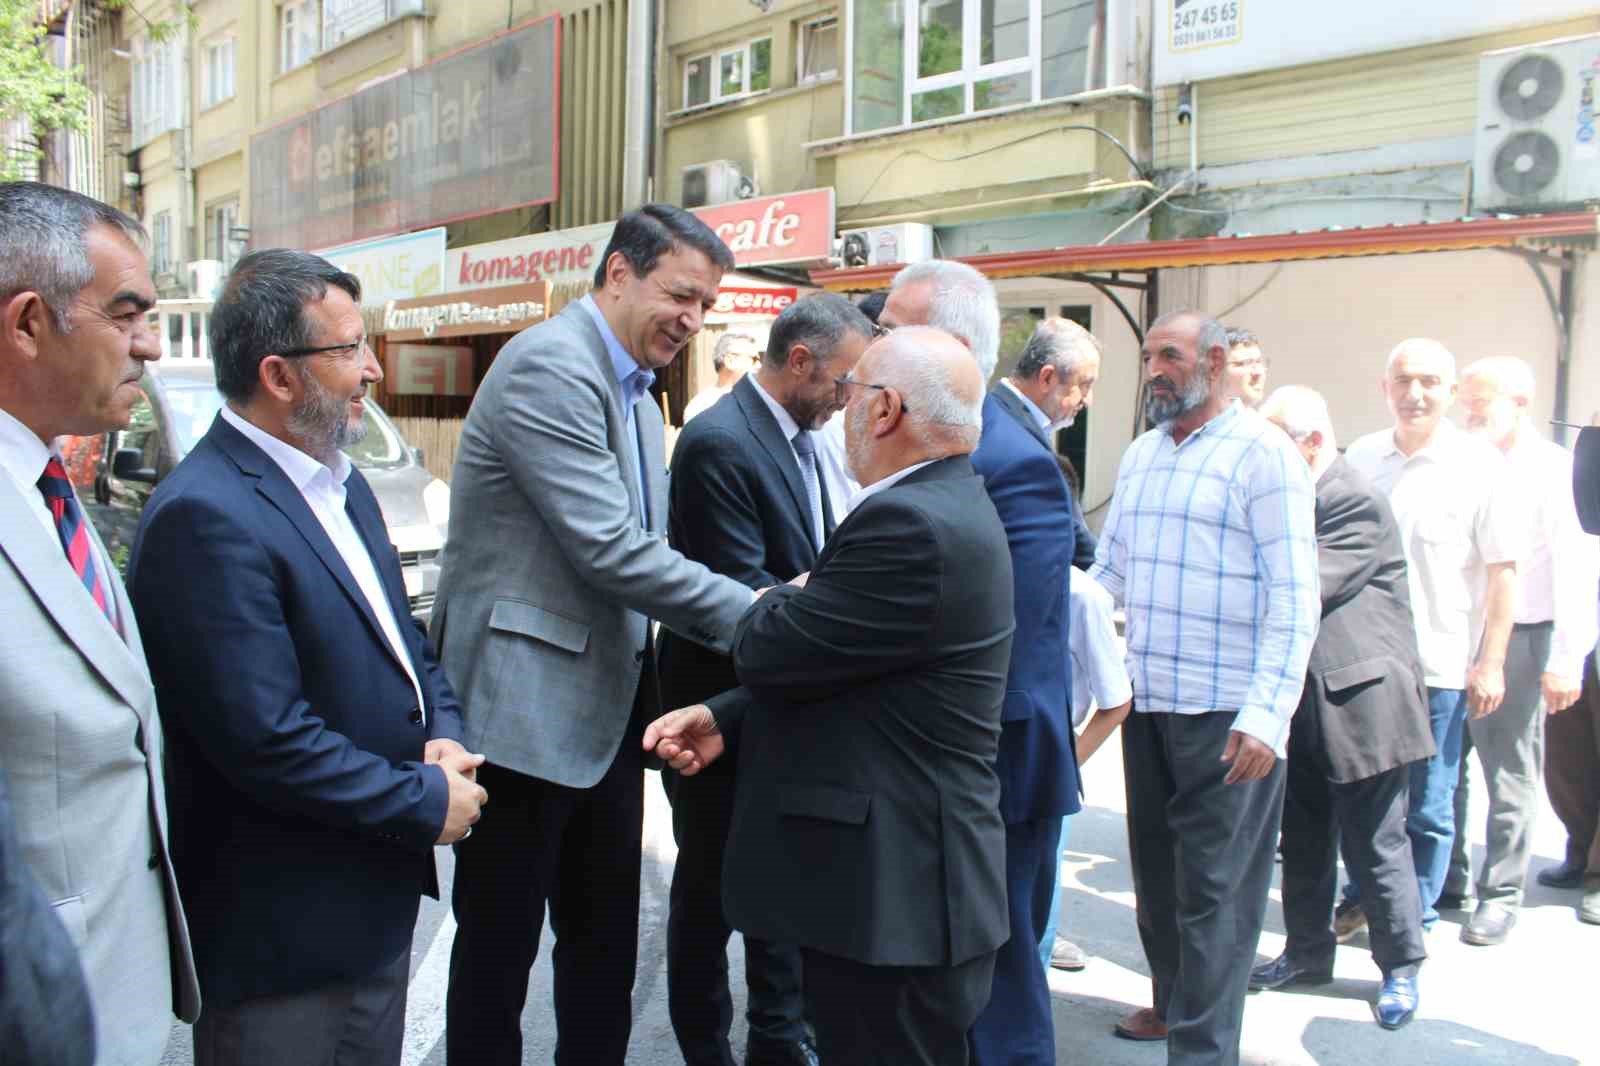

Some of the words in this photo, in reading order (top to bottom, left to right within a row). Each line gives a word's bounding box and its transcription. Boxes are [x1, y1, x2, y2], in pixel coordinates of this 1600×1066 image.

[1174, 8, 1199, 30] 247
[1200, 5, 1218, 24] 45
[1220, 2, 1237, 21] 65
[714, 200, 801, 252] cafe
[458, 243, 594, 284] komagene
